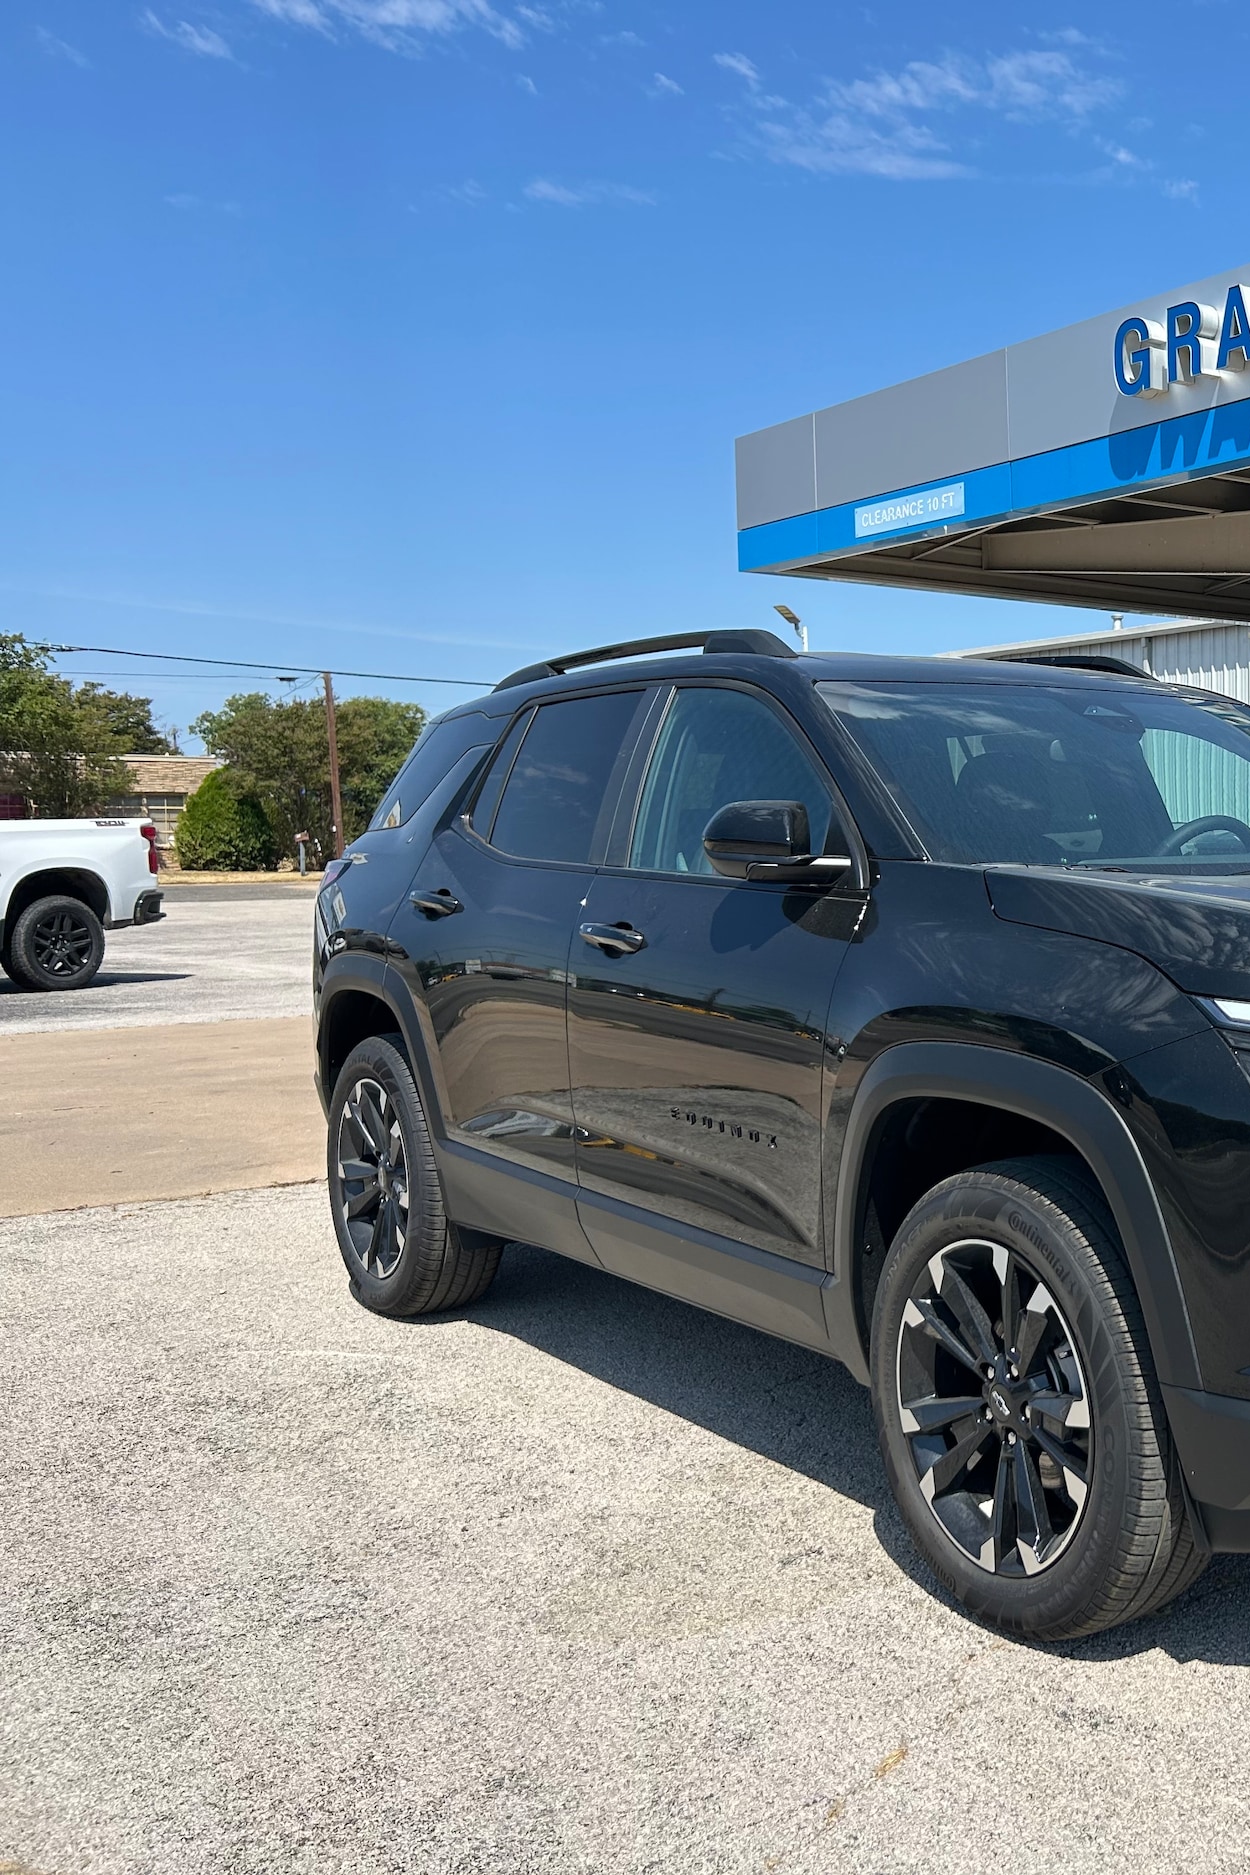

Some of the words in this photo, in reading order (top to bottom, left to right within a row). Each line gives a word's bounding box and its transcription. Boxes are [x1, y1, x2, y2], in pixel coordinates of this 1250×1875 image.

[861, 499, 924, 527] CLEARANCE
[927, 496, 939, 513] 10
[941, 492, 955, 509] FT
[1008, 1209, 1072, 1281] Continental
